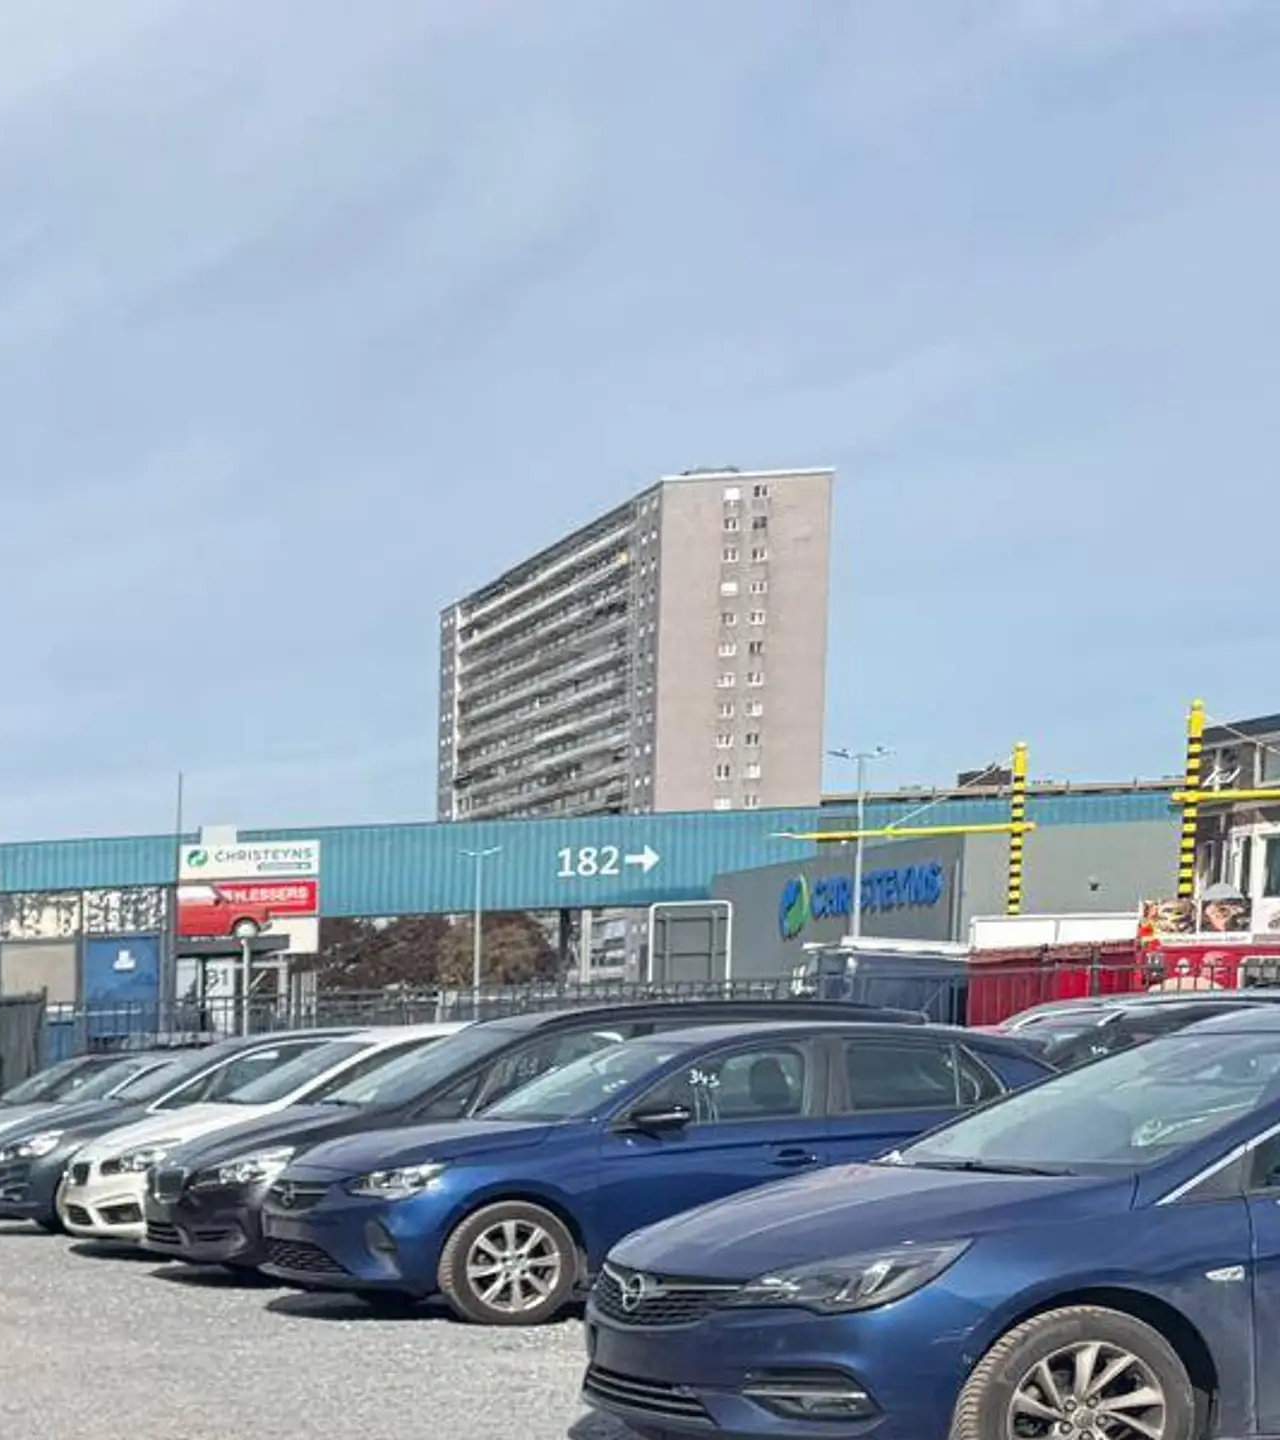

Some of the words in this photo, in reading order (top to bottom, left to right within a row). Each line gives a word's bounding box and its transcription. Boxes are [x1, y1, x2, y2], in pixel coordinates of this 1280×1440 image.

[213, 847, 314, 863] CHRISTEYNS
[556, 845, 620, 878] 182
[811, 858, 945, 917] CHRSTEYNS
